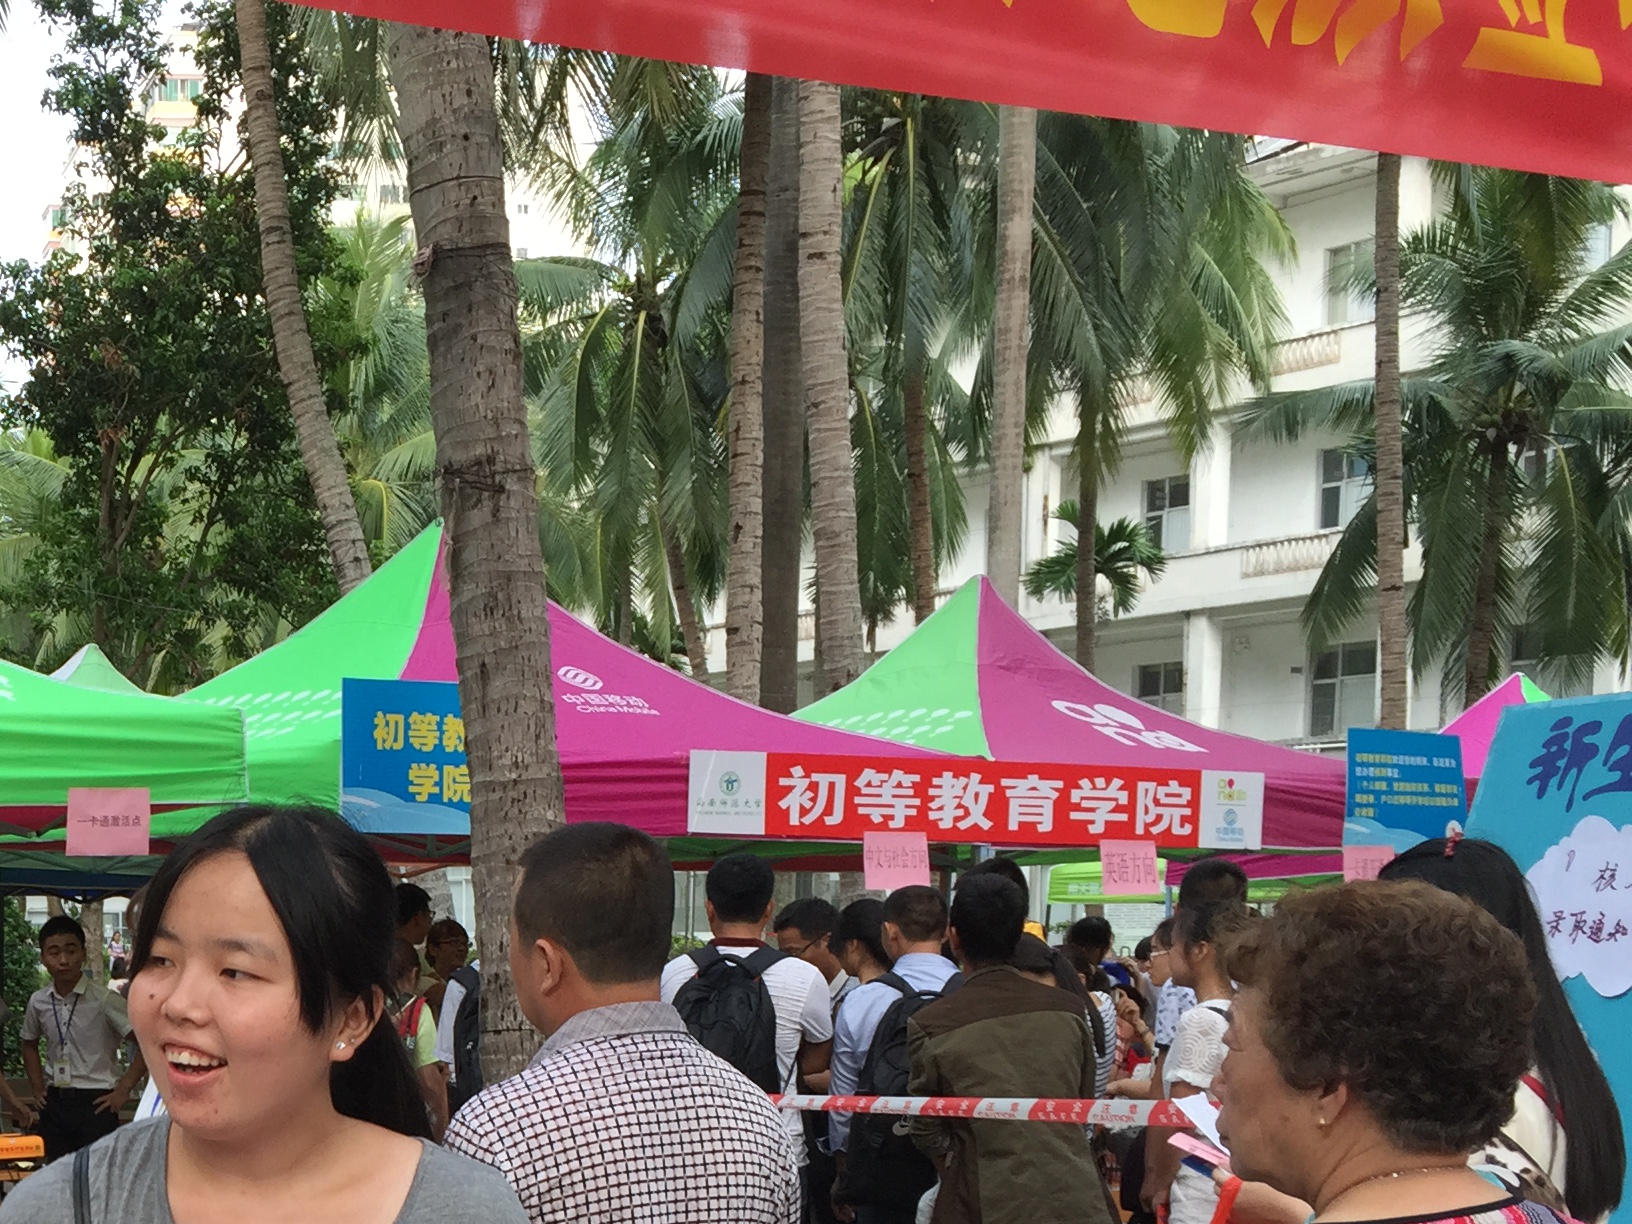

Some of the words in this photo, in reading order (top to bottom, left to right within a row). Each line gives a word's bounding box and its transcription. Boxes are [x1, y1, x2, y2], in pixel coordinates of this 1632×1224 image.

[408, 763, 472, 802] 学院
[777, 765, 1194, 837] 初等教育学院
[1104, 852, 1156, 884] 英语方向
